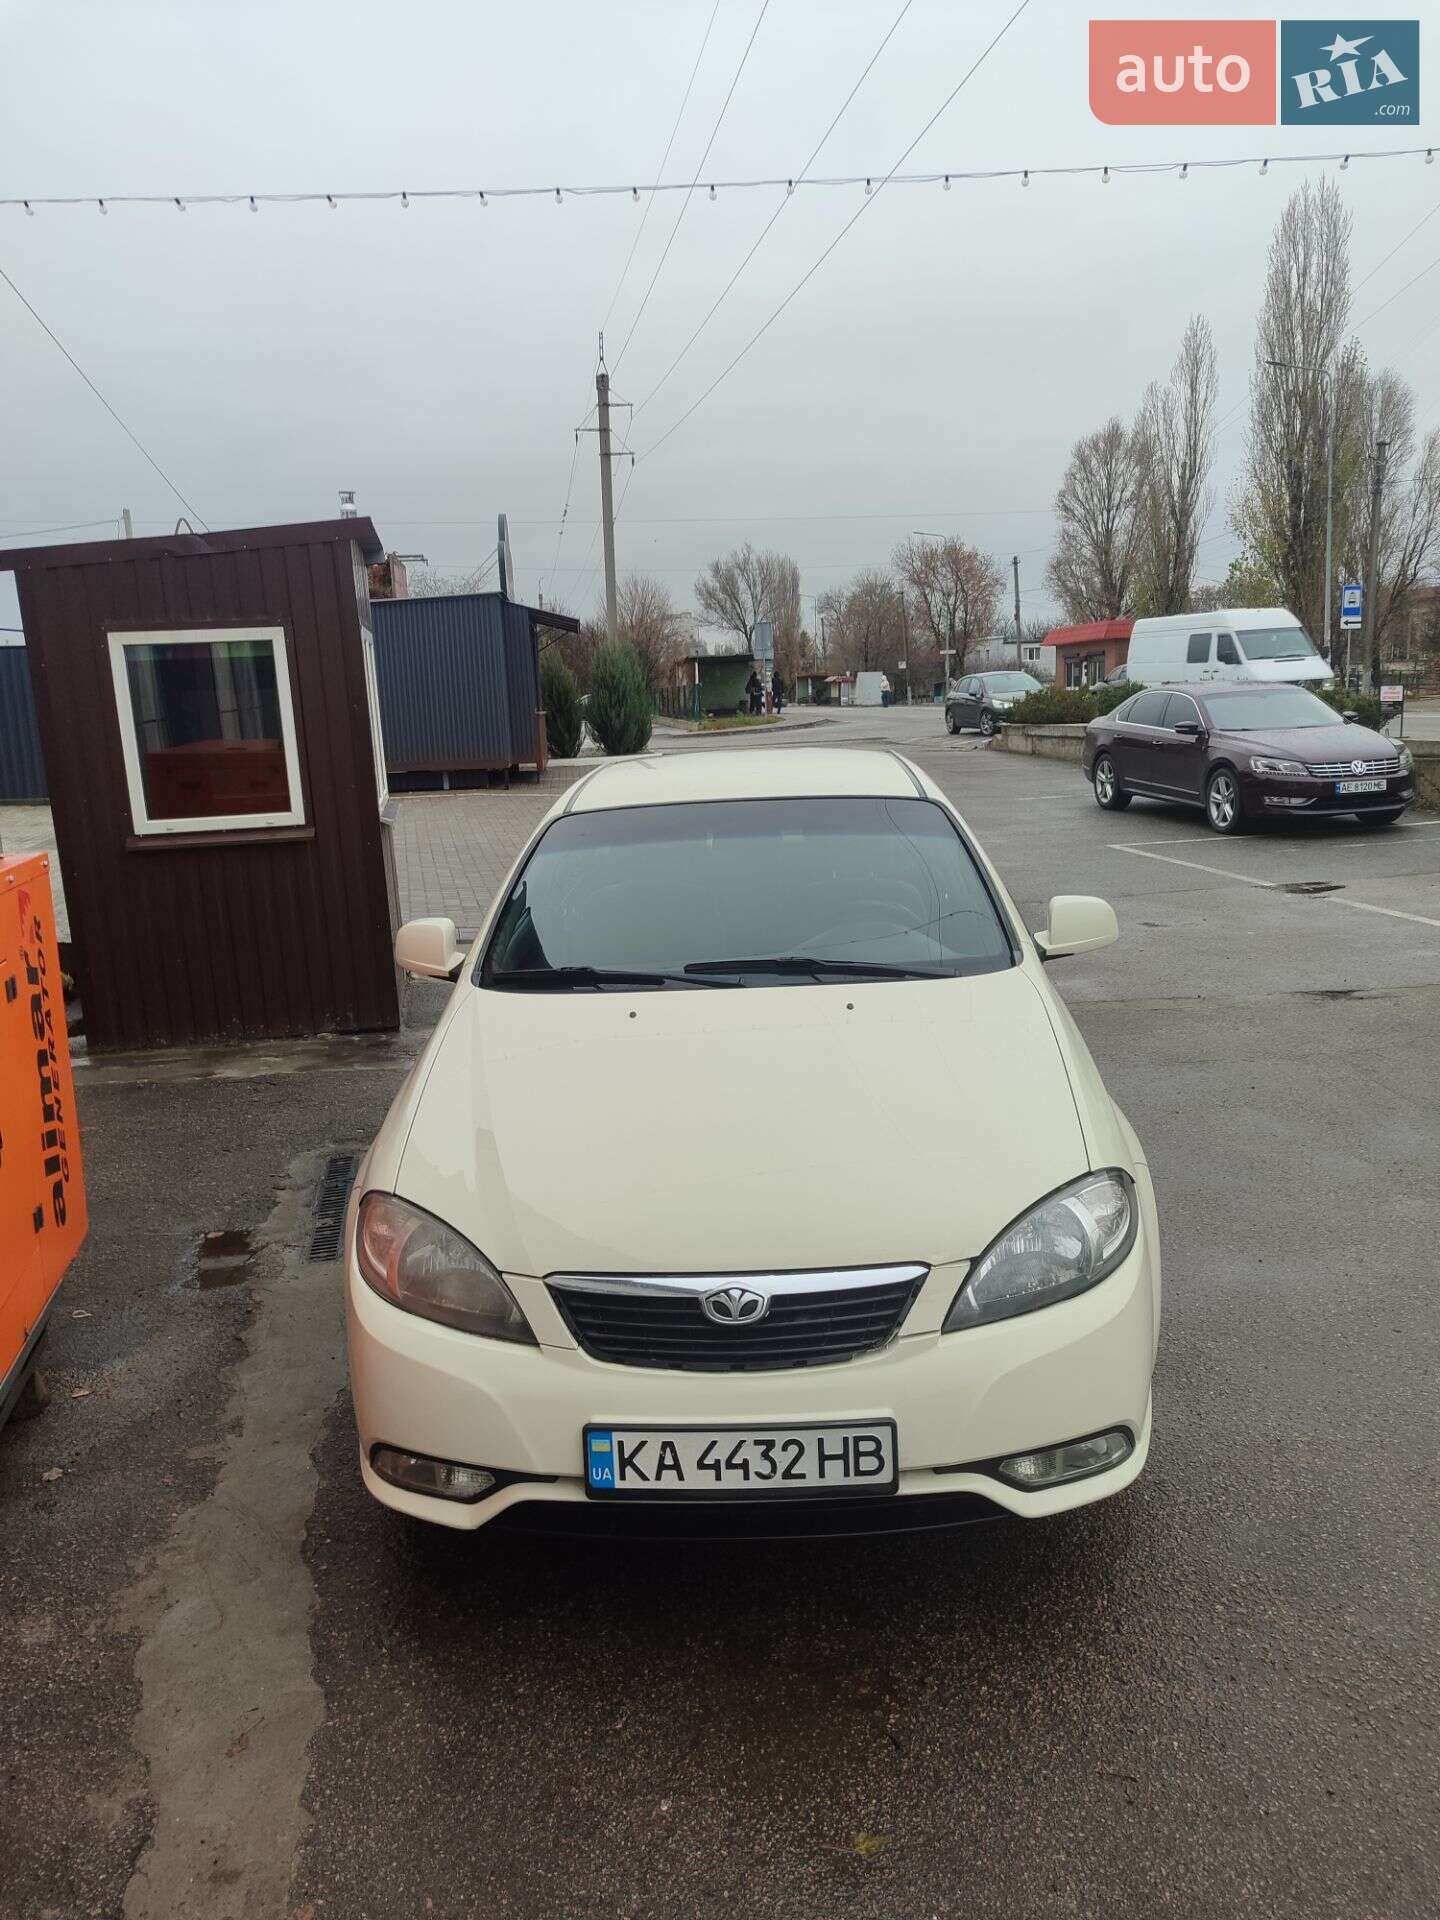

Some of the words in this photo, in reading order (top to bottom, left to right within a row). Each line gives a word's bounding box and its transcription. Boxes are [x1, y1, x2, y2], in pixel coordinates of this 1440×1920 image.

[25, 947, 65, 1228] alimar
[32, 915, 69, 1183] GENERATOR
[592, 1467, 612, 1481] UA
[617, 1440, 685, 1481] KA
[696, 1439, 807, 1481] 4432
[818, 1435, 886, 1478] HB
